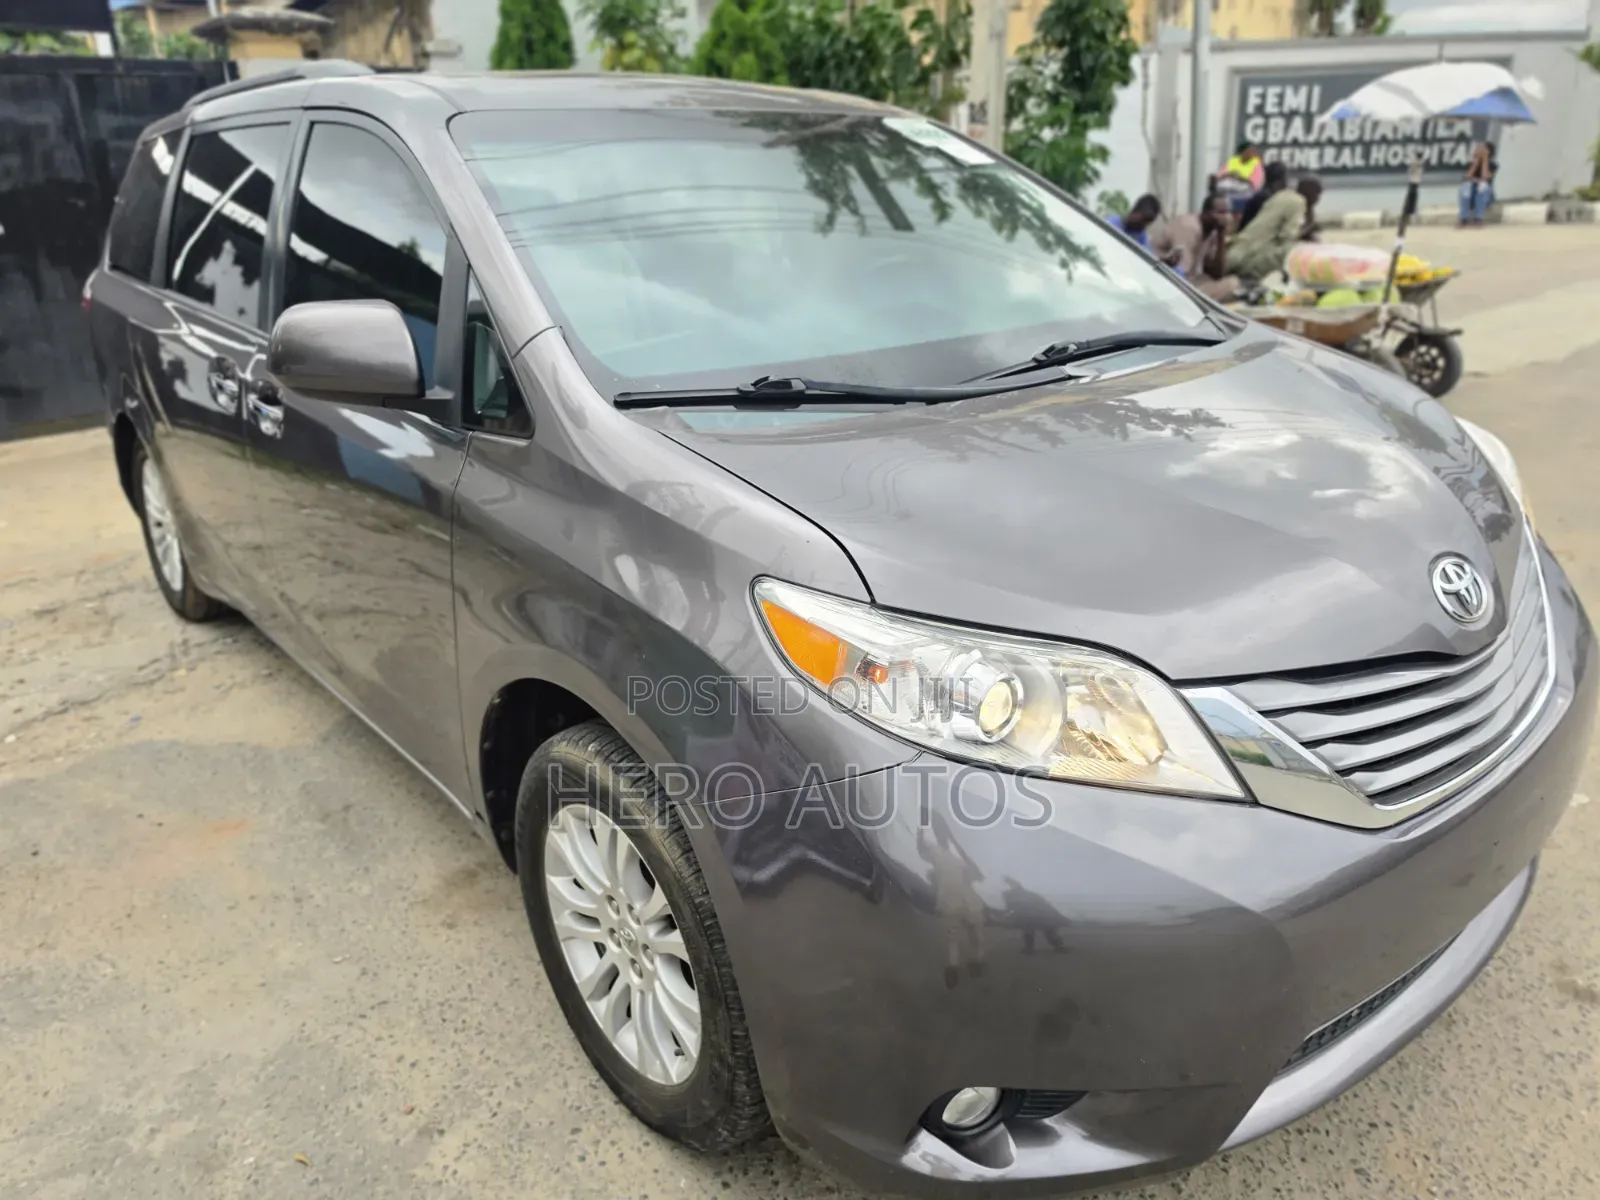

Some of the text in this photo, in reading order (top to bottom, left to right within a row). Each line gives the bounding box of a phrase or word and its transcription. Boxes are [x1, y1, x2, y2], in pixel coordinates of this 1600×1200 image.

[1246, 84, 1322, 114] FEMI
[1244, 115, 1472, 143] GBAJABIAMILA
[1263, 144, 1366, 169] GENERAL
